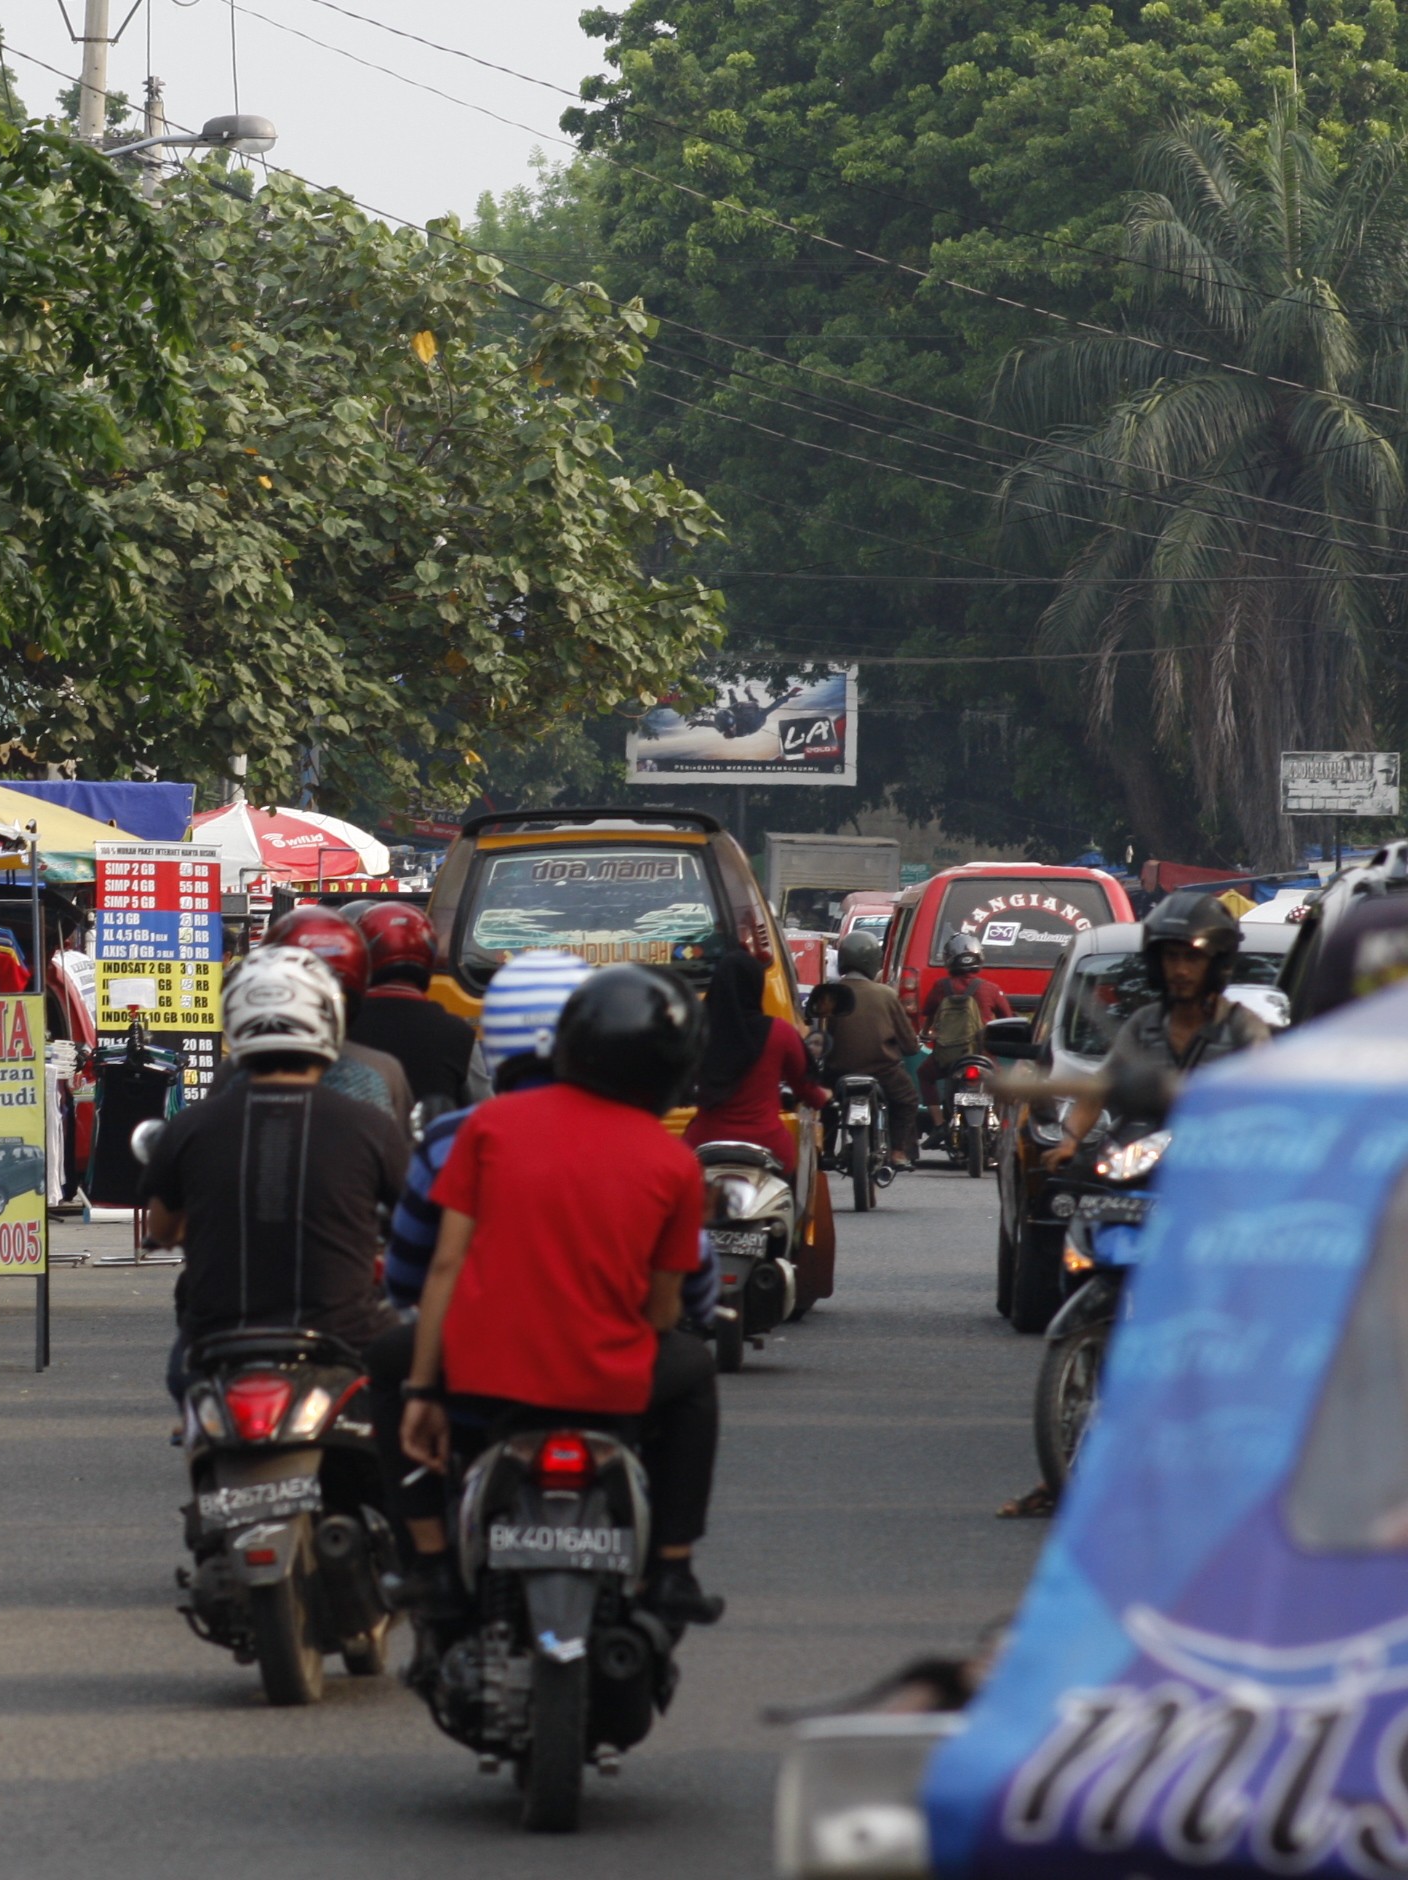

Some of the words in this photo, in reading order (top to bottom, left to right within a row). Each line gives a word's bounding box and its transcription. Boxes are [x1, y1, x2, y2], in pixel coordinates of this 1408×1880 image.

[784, 721, 830, 750] LA
[105, 863, 129, 876] SIMP
[141, 863, 155, 876] GB
[195, 865, 208, 877] RB
[531, 859, 590, 882] doa
[105, 880, 129, 892] SIMP
[141, 880, 155, 893] GB
[180, 881, 193, 893] 55
[195, 882, 208, 893] RB
[105, 896, 129, 908] SIMP
[195, 898, 208, 909] RB
[103, 913, 115, 925] XL
[125, 913, 140, 925] GB
[195, 914, 208, 926] RB
[103, 929, 115, 942] XL
[116, 930, 133, 943] 4,5
[134, 930, 149, 942] GB
[195, 931, 209, 942] RB
[103, 946, 126, 958] AXIS
[140, 946, 154, 958] GB
[195, 947, 209, 959] RB
[103, 963, 146, 975] INDOSAT
[158, 963, 171, 975] GB
[195, 964, 209, 975] RB
[158, 980, 172, 991] GB
[196, 981, 209, 992] RB
[159, 996, 172, 1008] GB
[194, 997, 207, 1008] RB
[149, 1011, 164, 1023] 10
[165, 1012, 178, 1023] GB
[181, 1012, 198, 1023] 100
[200, 1013, 214, 1024] RB
[183, 1039, 197, 1051] 20
[198, 1039, 212, 1051] RB
[184, 1088, 198, 1099] 55
